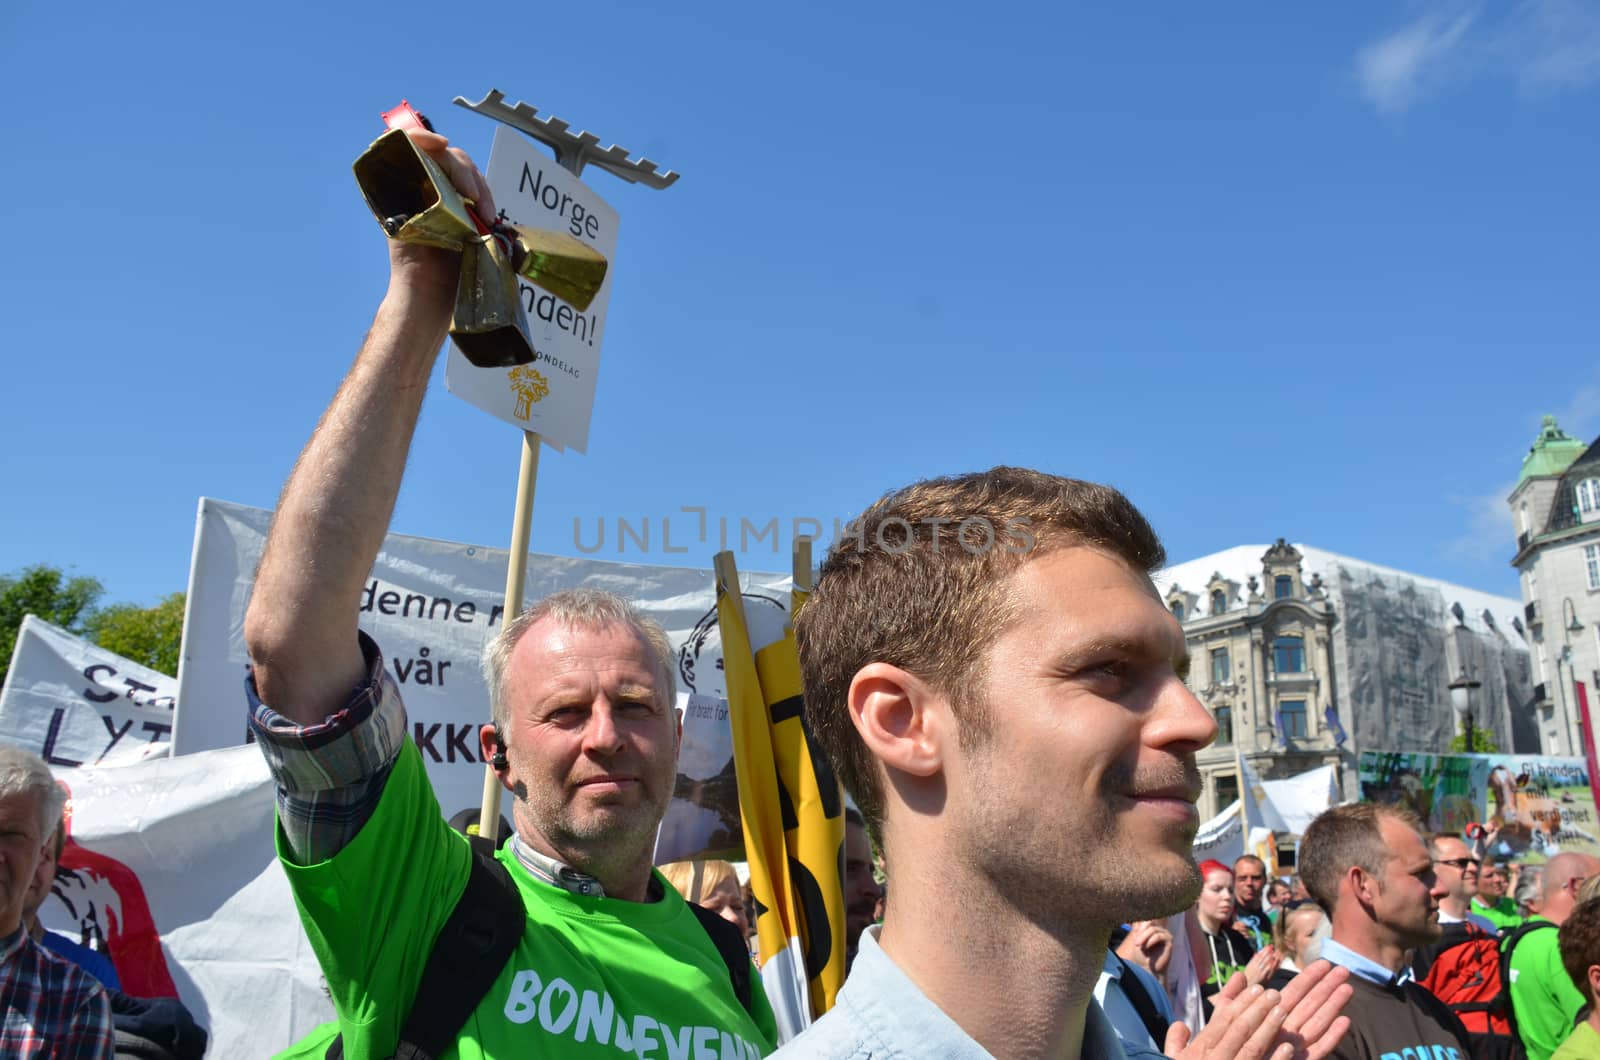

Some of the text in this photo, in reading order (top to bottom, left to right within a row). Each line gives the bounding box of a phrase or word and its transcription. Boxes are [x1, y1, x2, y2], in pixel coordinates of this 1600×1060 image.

[519, 161, 599, 239] Norge
[519, 281, 597, 348] nden!
[535, 351, 581, 379] ONDELAG
[360, 580, 477, 624] denne
[393, 647, 452, 687] vår
